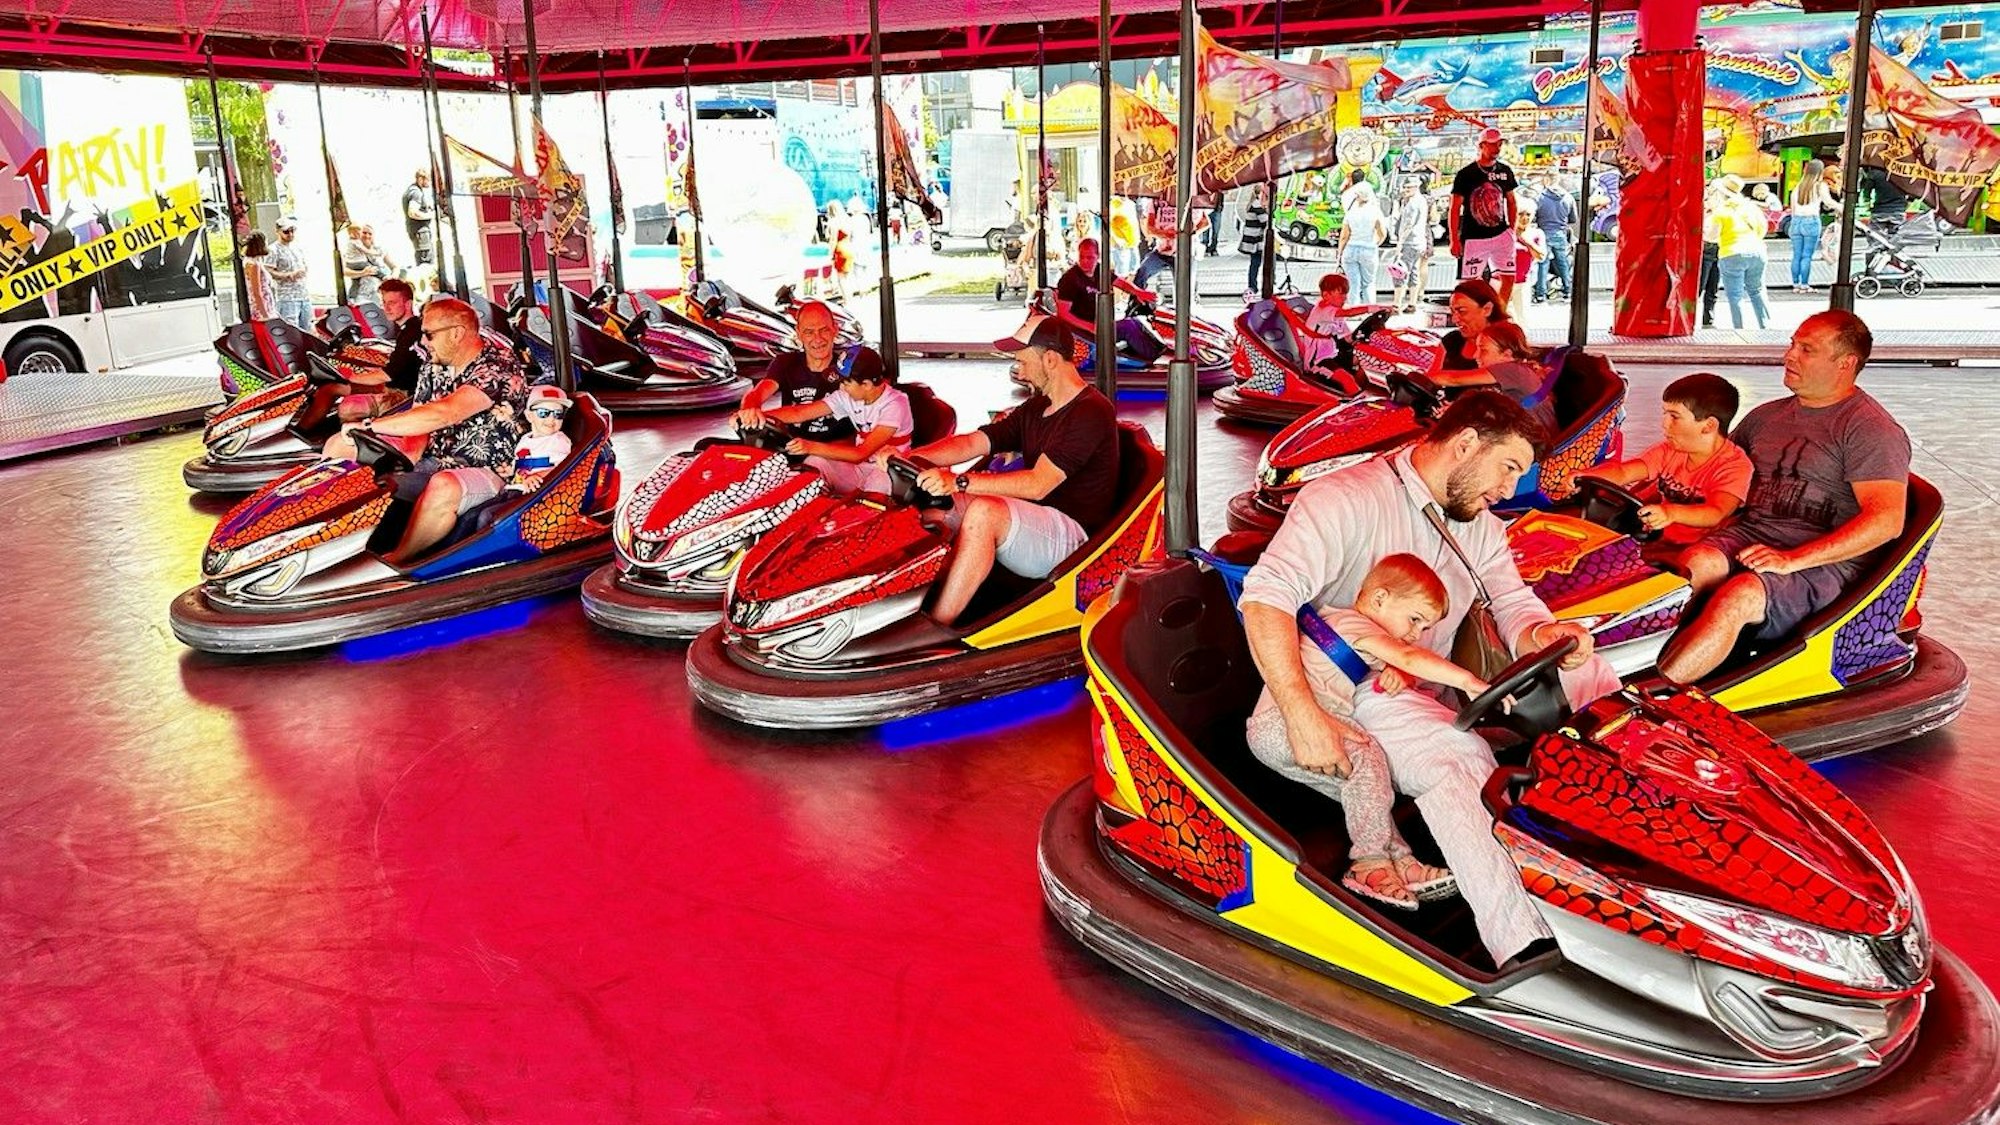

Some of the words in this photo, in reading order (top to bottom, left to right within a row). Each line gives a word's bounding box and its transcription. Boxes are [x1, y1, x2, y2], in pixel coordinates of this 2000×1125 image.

[1890, 161, 1916, 175] ONLY
[1963, 174, 1981, 186] VIP
[10, 261, 63, 300] ONLY
[85, 238, 118, 268] VIP
[123, 217, 169, 252] ONLY
